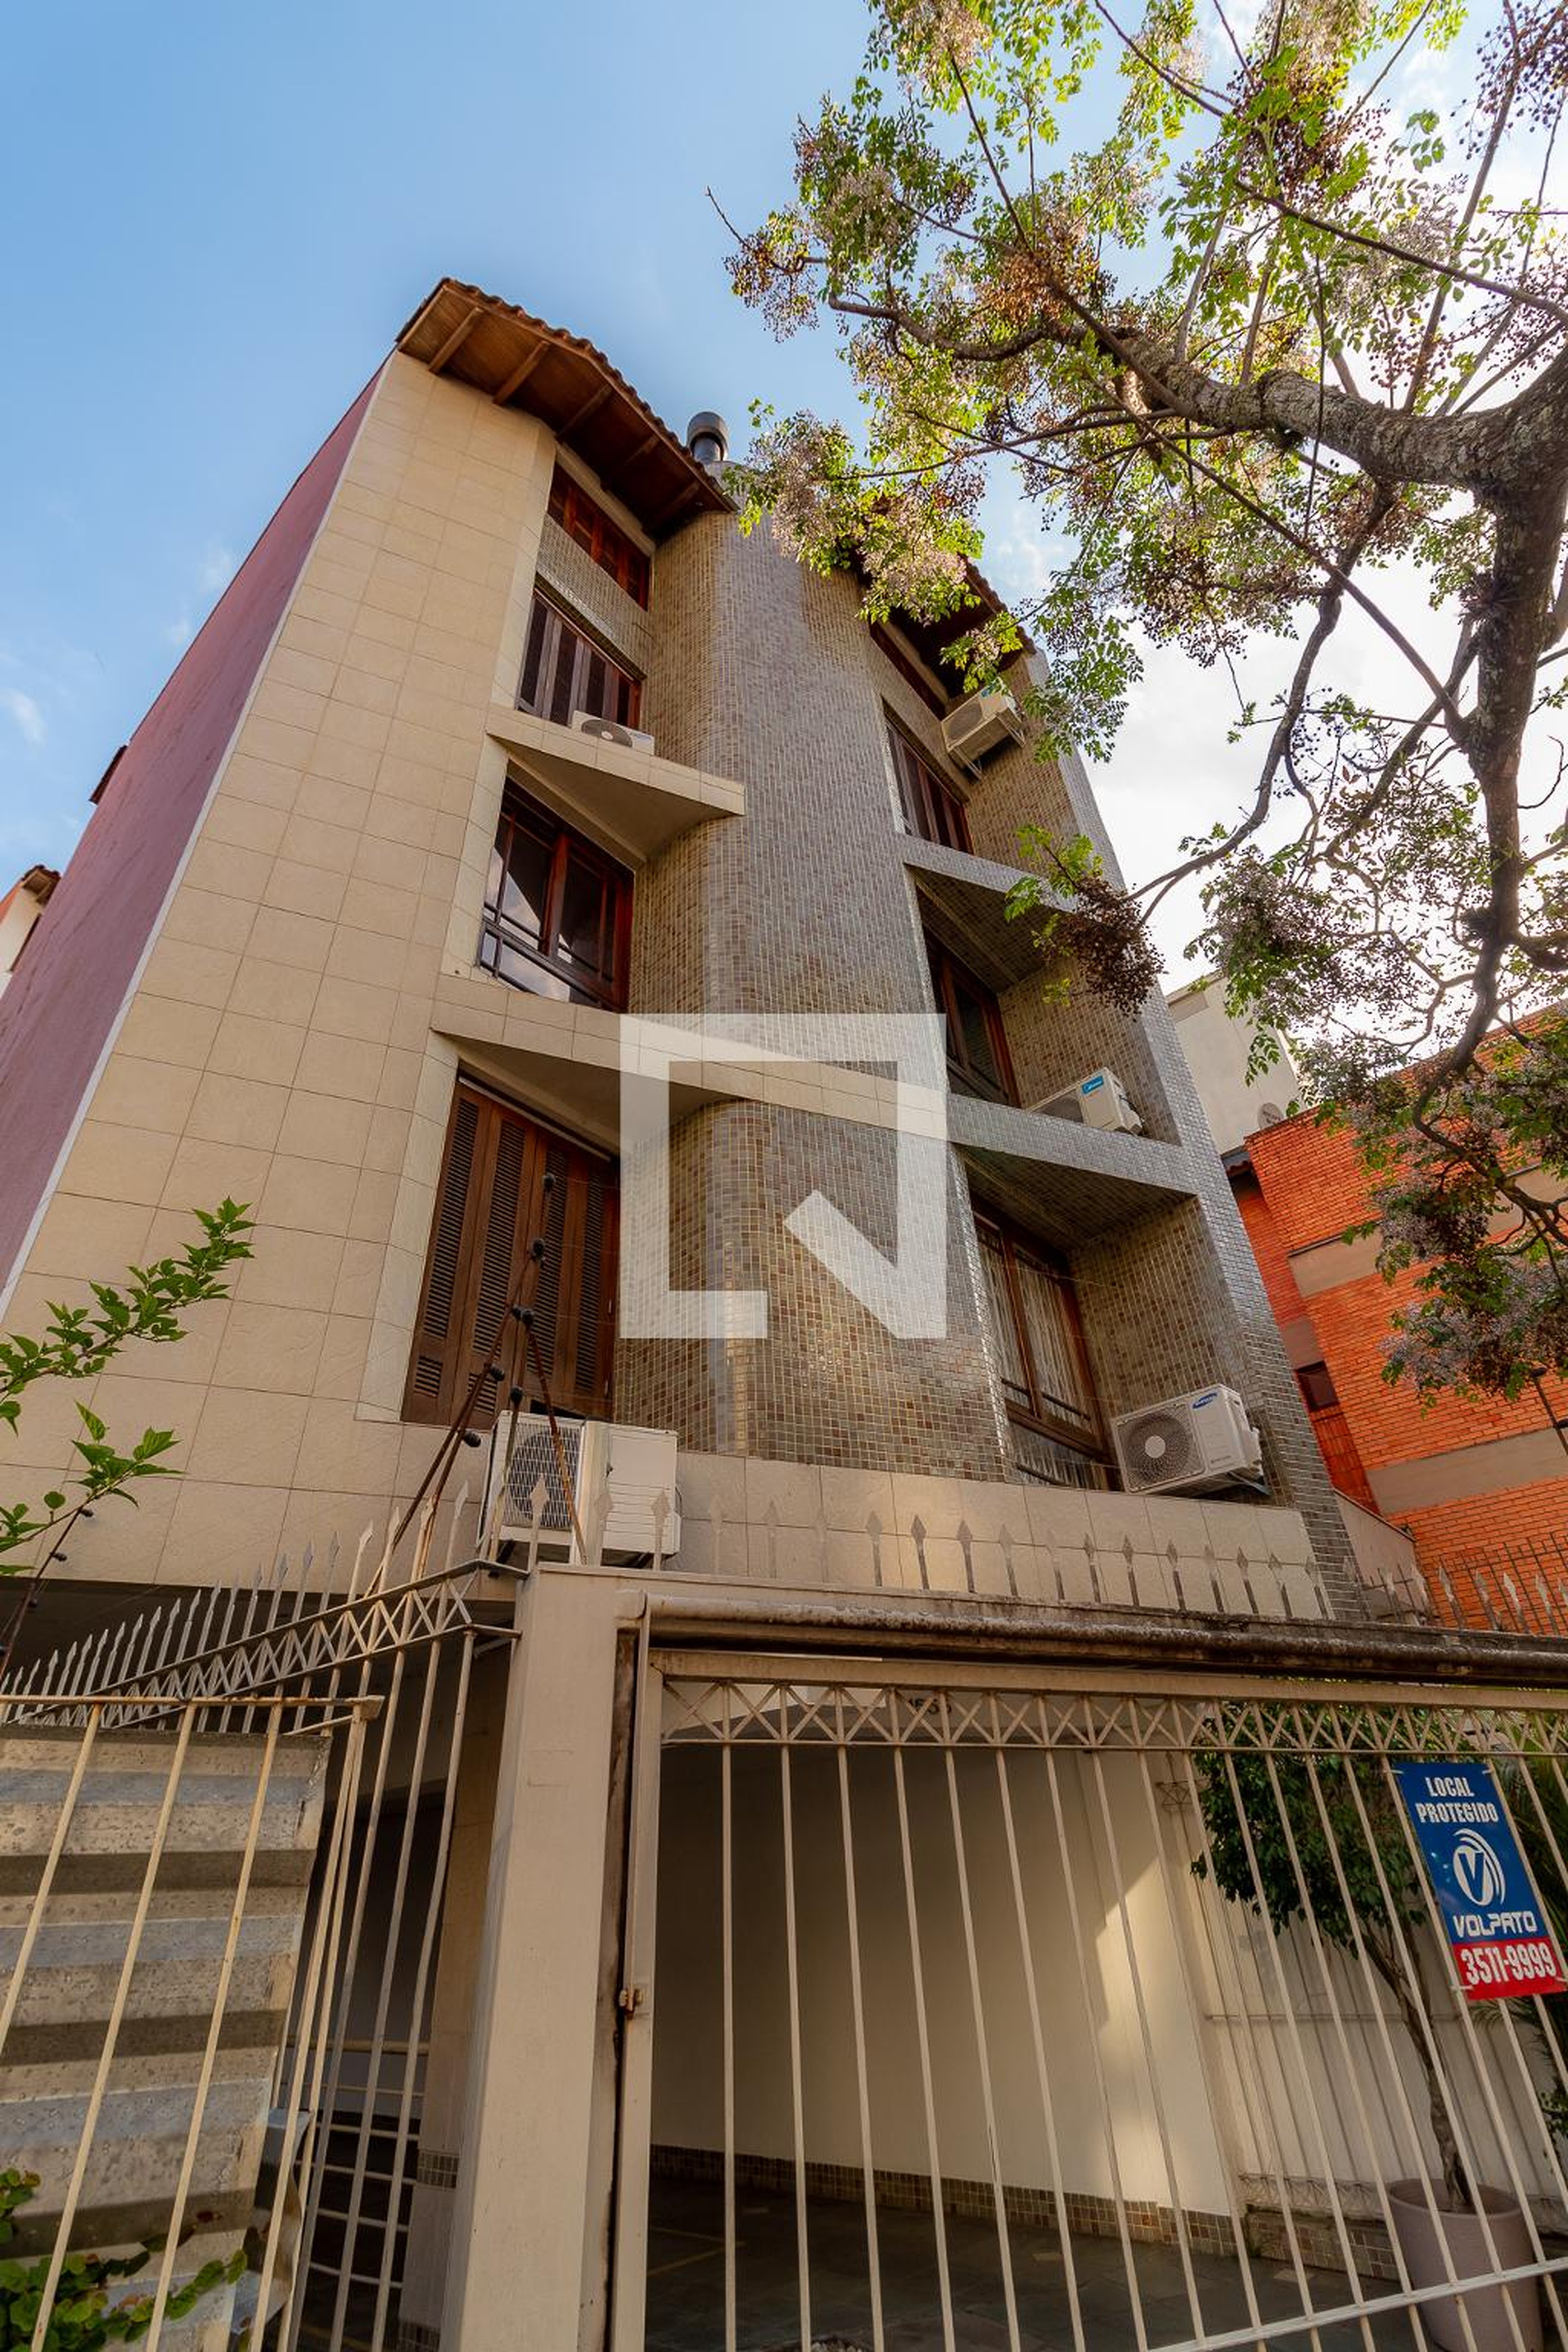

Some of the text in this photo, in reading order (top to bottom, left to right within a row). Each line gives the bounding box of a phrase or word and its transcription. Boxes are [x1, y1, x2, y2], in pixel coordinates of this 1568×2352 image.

[1425, 1777, 1475, 1797] LOCAL
[1415, 1802, 1499, 1823] PROTEGIDO
[1453, 1911, 1537, 1938] VOLPATO
[1461, 1942, 1556, 1985] 3511-9999
